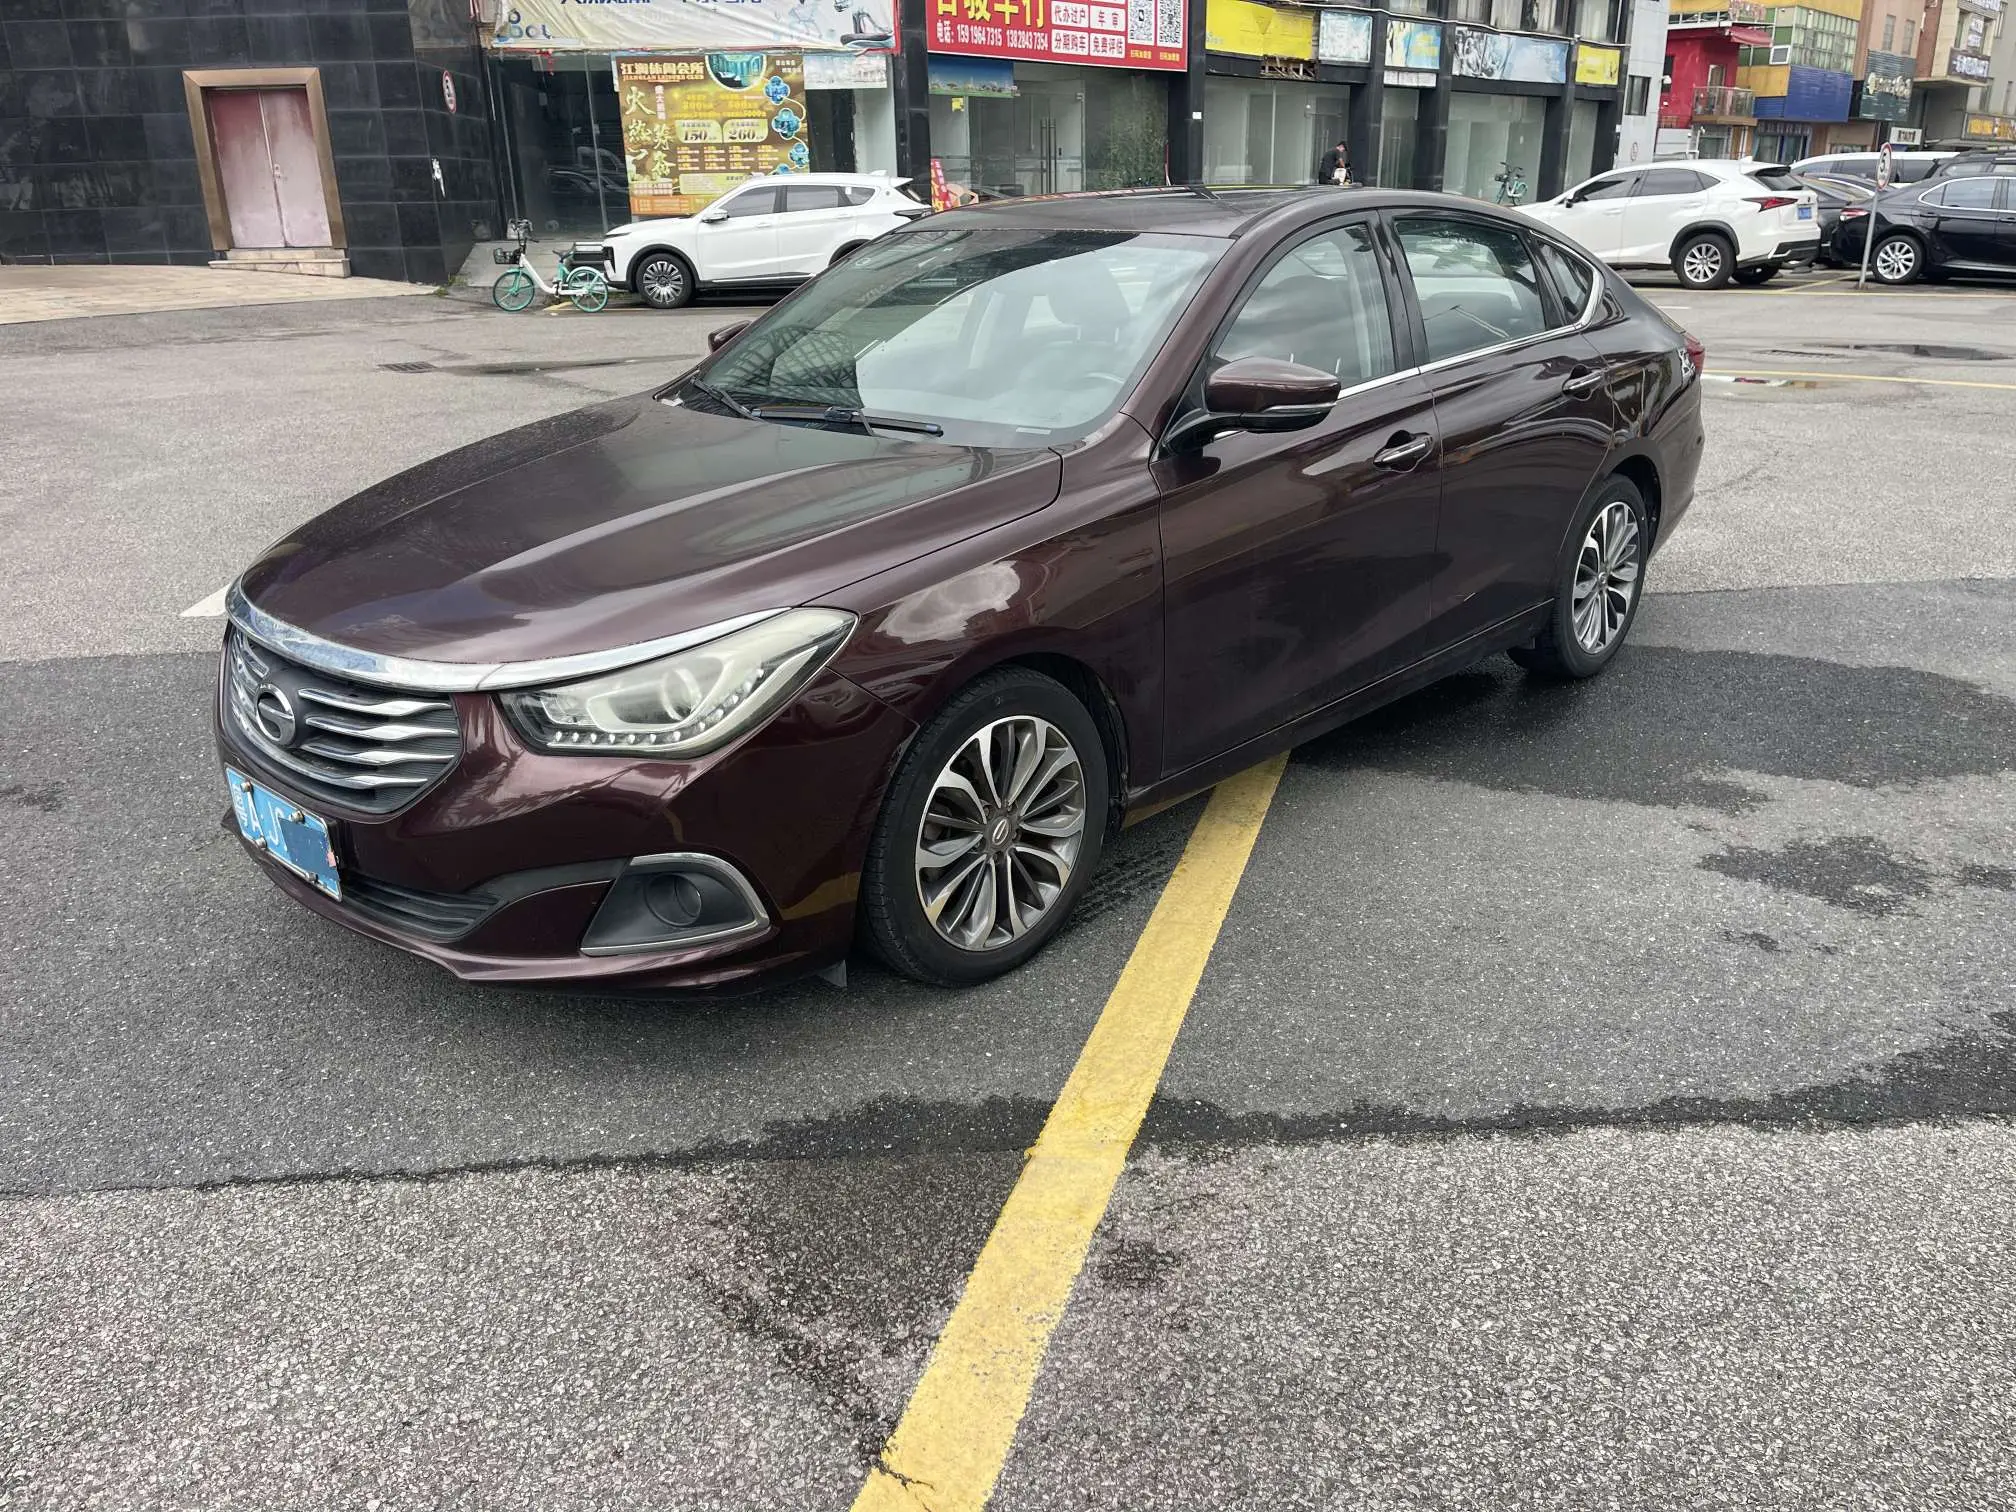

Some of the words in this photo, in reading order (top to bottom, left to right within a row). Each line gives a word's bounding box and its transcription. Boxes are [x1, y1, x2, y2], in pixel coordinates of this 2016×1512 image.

[1054, 4, 1086, 25] 代办过户
[1054, 32, 1087, 53] 分期购车
[1092, 35, 1123, 55] 免费评估
